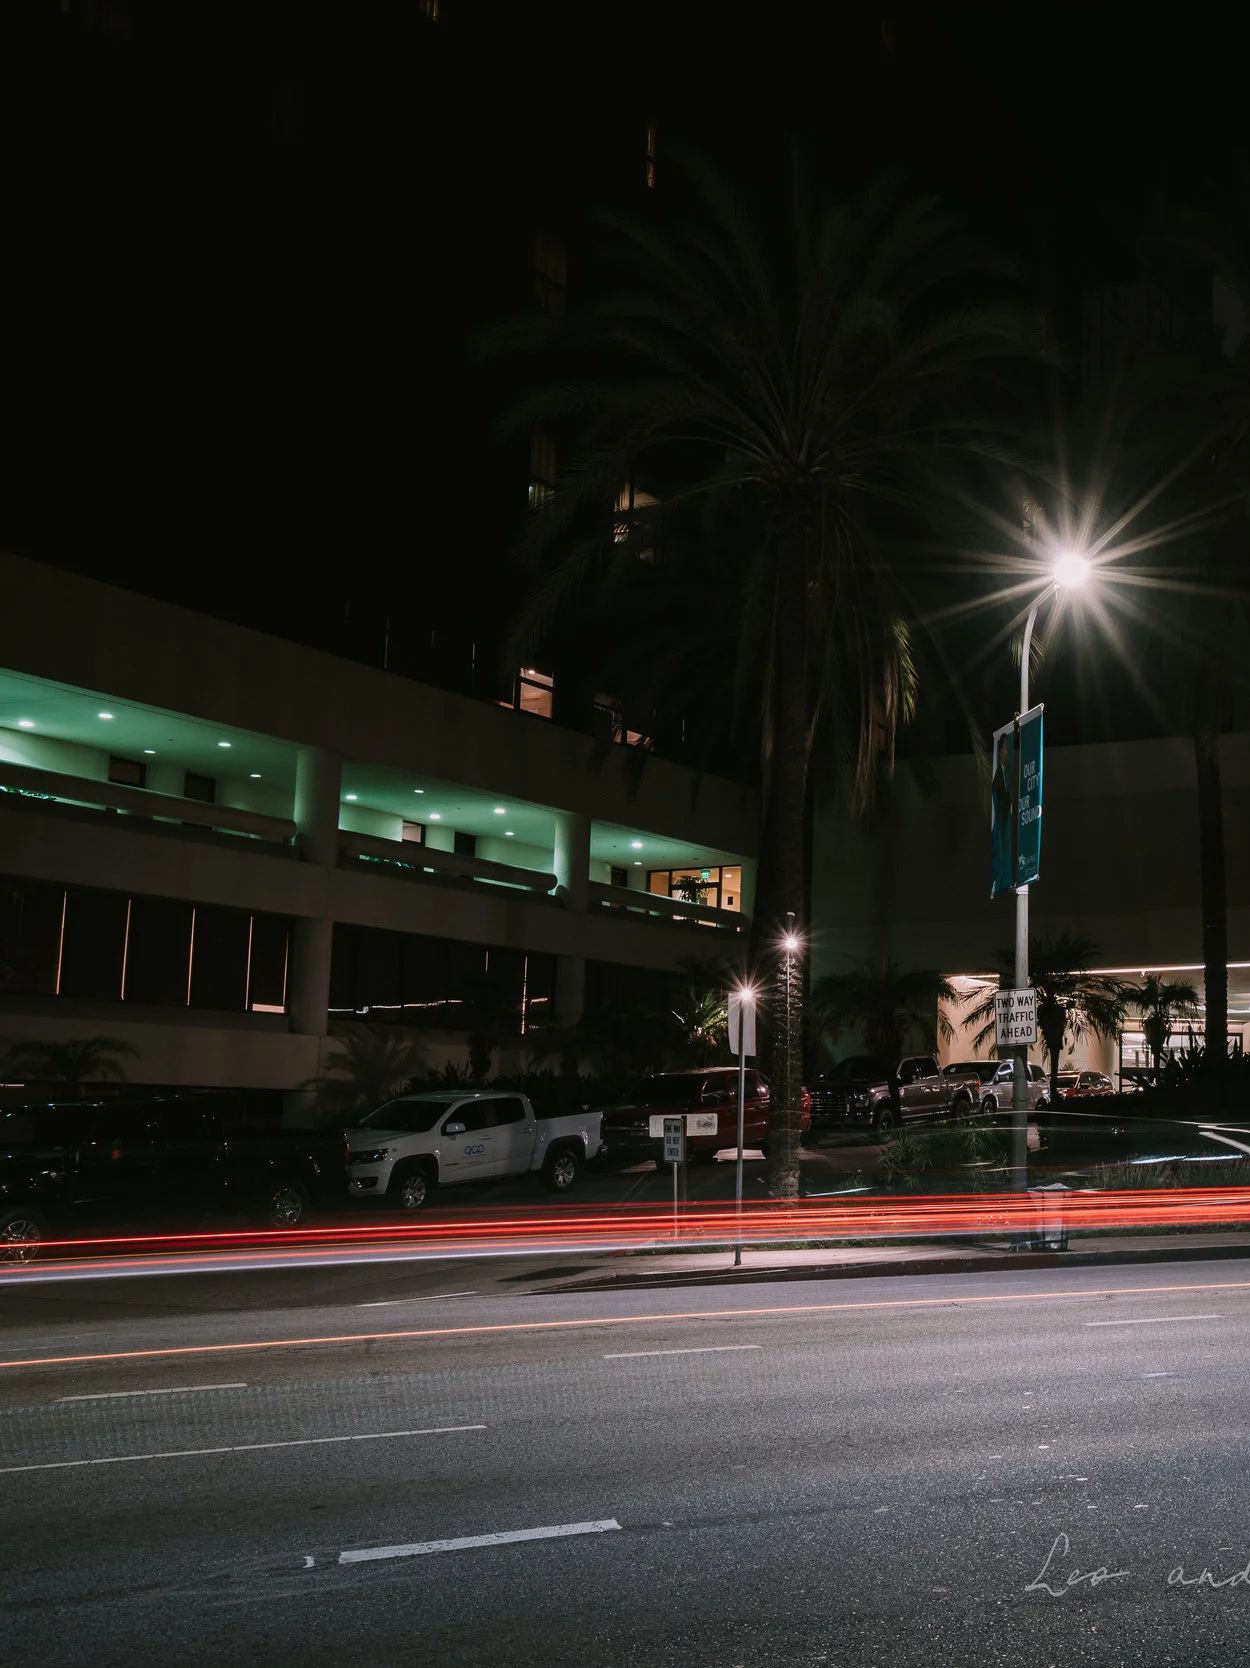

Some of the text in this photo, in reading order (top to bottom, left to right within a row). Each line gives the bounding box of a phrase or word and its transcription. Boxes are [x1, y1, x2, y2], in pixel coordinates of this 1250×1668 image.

[1023, 760, 1036, 778] OUR
[1027, 772, 1041, 791] CITY
[1021, 805, 1042, 826] SOUND
[997, 996, 1034, 1008] TWO WAY
[998, 1011, 1034, 1023] TRAFFIC
[1001, 1027, 1032, 1038] AHEAD
